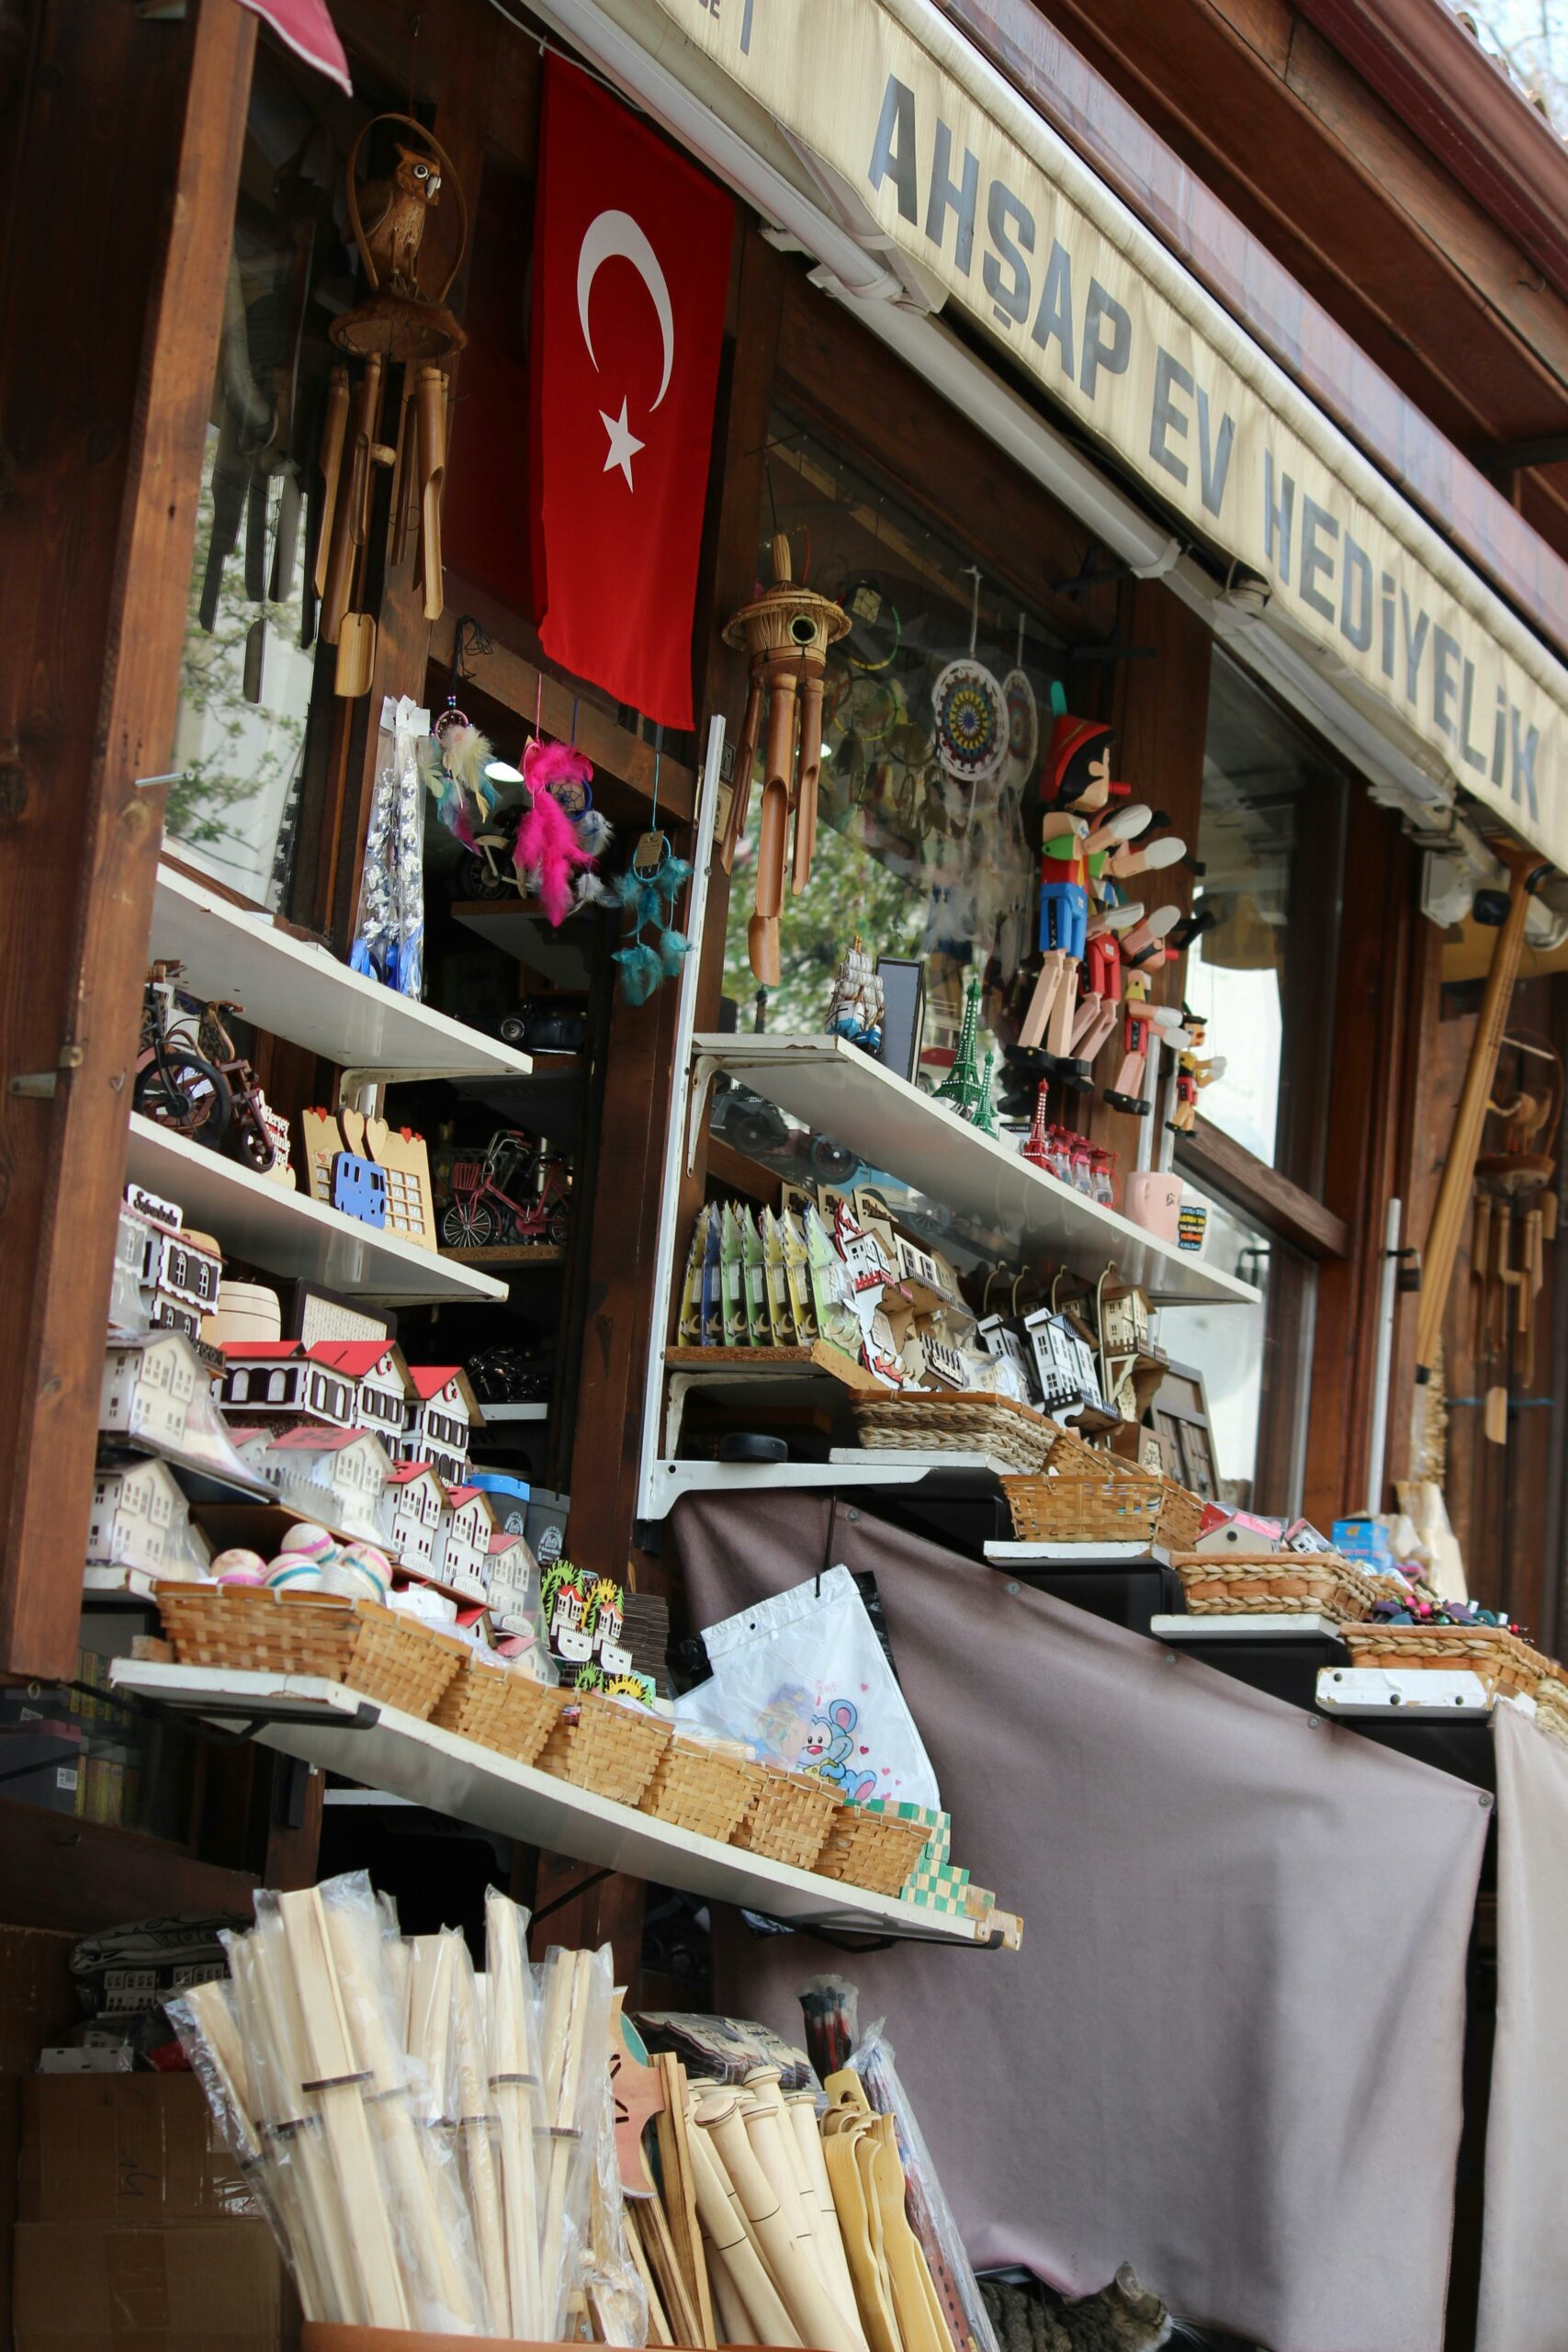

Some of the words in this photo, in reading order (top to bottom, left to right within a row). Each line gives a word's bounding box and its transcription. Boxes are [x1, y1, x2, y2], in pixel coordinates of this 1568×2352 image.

[868, 74, 1132, 401] AHŞAP
[1149, 345, 1235, 520] EV
[1264, 447, 1540, 823] HEDİYELİK
